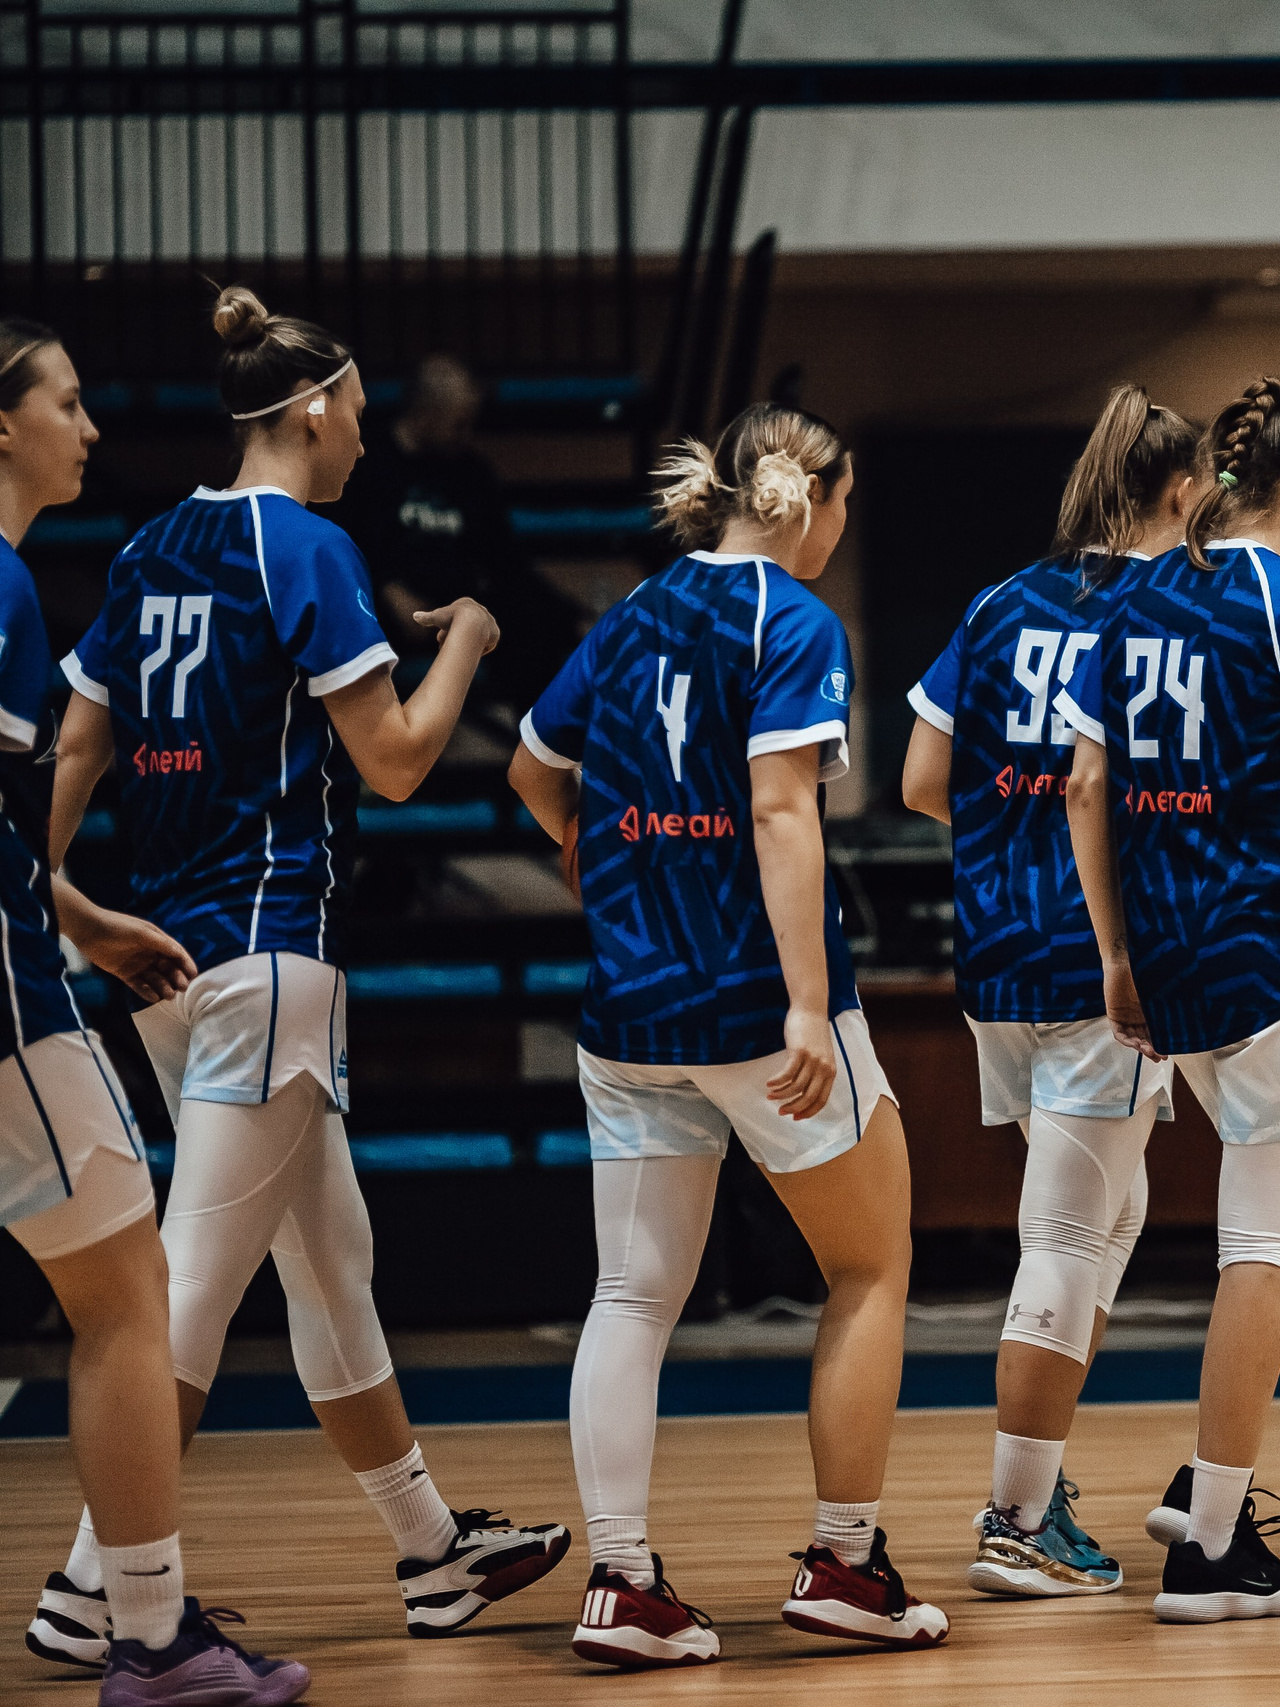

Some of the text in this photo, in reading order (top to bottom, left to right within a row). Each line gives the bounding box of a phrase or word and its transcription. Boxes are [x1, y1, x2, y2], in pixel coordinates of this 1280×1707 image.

[139, 594, 213, 718] 77
[1125, 637, 1206, 760] 24
[149, 740, 202, 774] летй
[1015, 773, 1071, 797] лет
[1136, 784, 1213, 815] летай
[645, 806, 736, 839] леай
